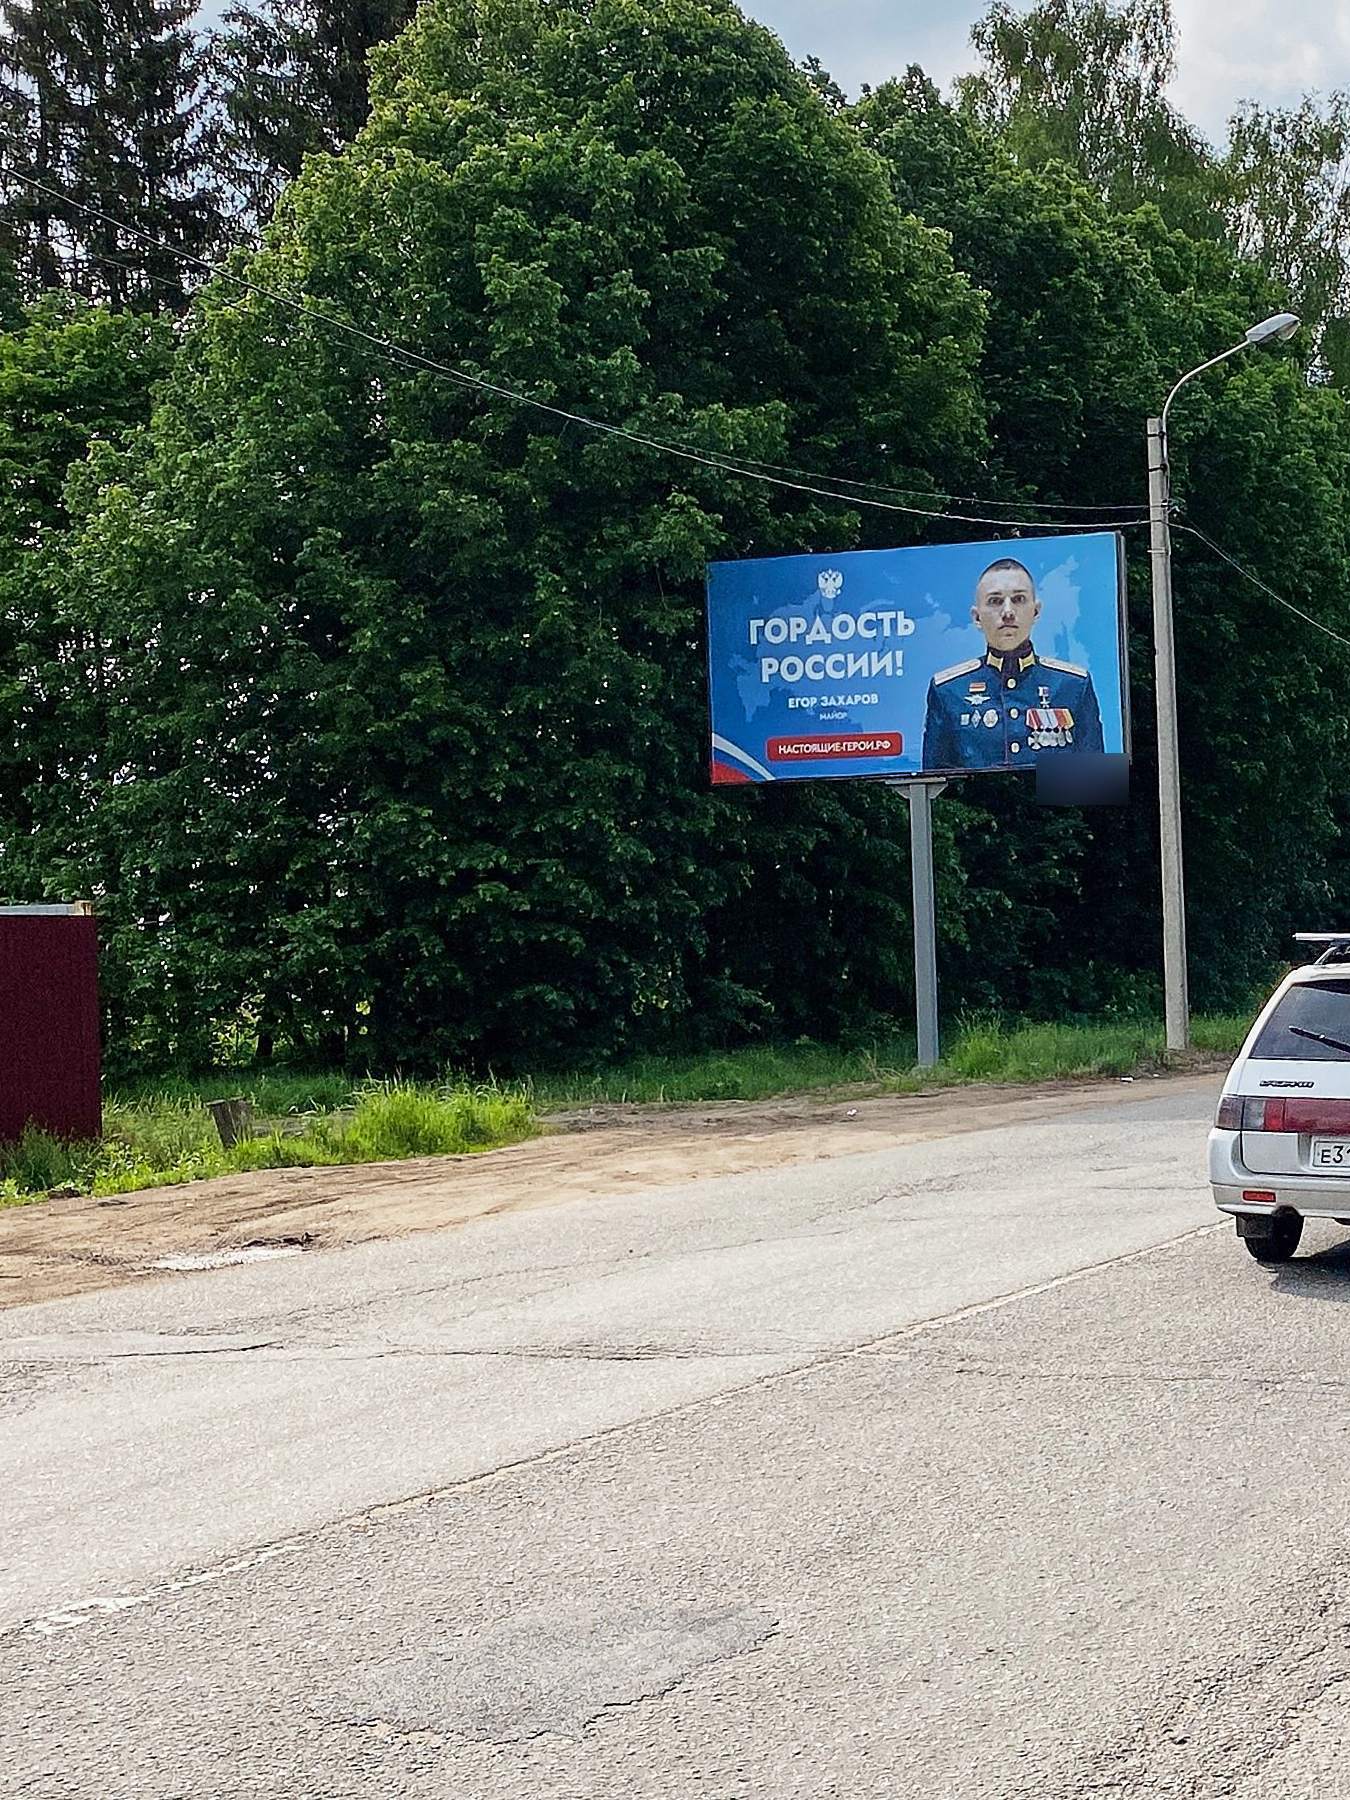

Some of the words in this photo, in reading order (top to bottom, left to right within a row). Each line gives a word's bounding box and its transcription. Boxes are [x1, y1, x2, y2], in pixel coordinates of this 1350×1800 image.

[749, 610, 916, 645] ГОРДОСТЬ
[761, 650, 904, 683] РОССИИ!
[788, 696, 818, 709] ЕГОР
[820, 693, 879, 707] ЗАХАРОВ
[819, 712, 848, 721] МАЙОР
[778, 740, 892, 755] НАСТОЯЩИЕ-ГЕРОИ.РФ
